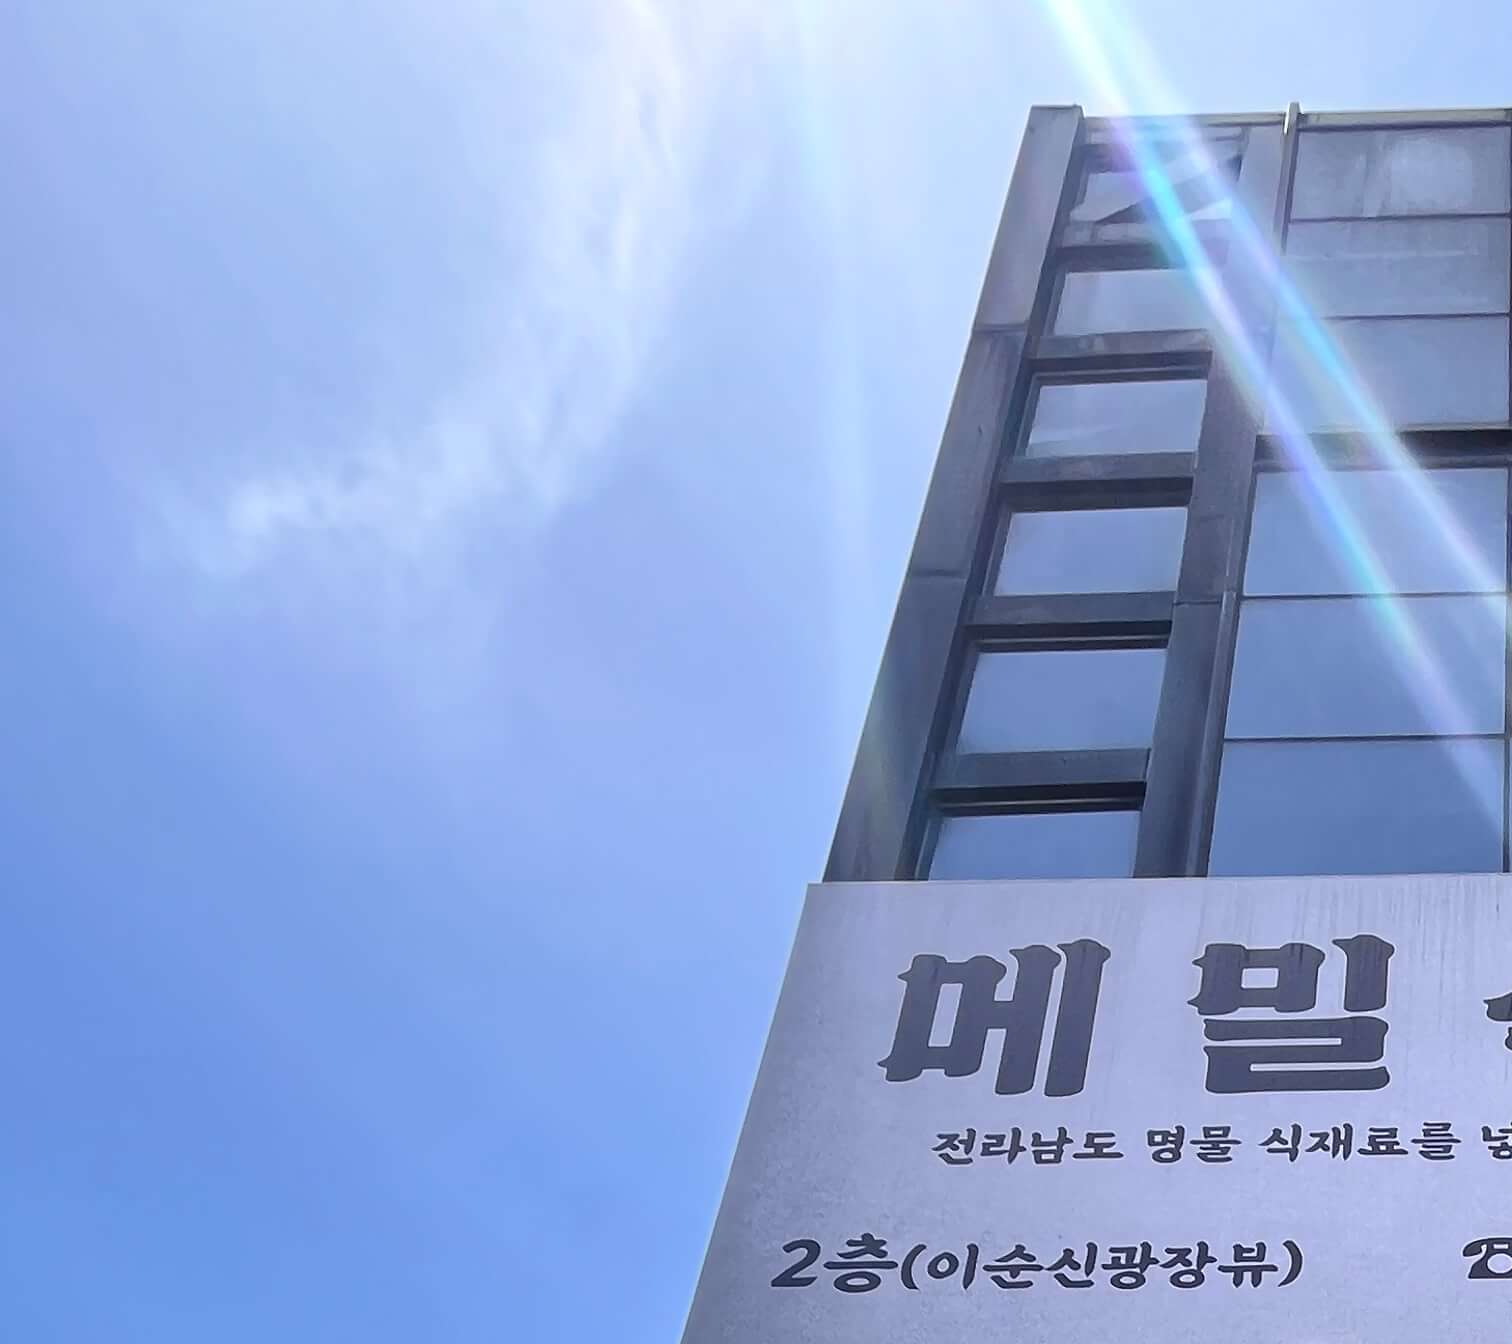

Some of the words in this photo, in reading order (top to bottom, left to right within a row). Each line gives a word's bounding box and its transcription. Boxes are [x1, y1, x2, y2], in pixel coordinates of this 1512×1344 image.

[934, 1122, 1122, 1165] 전라남도
[1147, 1122, 1240, 1163] 명물
[1260, 1120, 1462, 1161] 식재료를
[771, 1235, 1304, 1294] 2층(이순신광장뷰)
